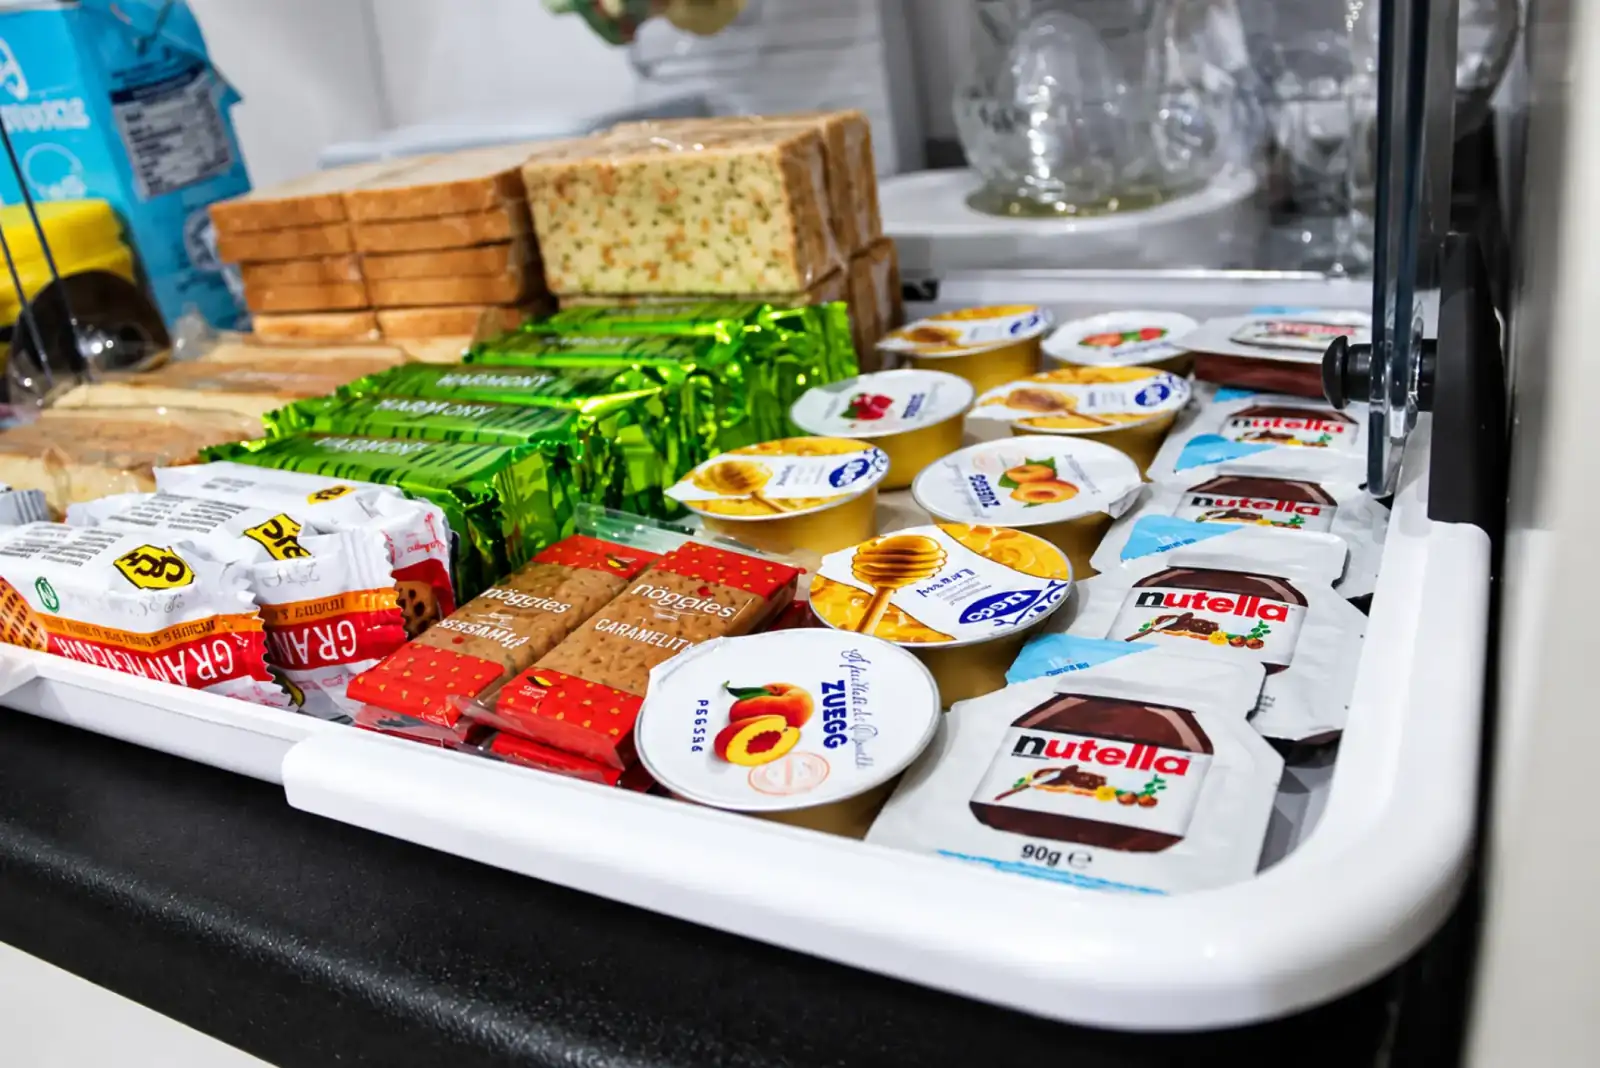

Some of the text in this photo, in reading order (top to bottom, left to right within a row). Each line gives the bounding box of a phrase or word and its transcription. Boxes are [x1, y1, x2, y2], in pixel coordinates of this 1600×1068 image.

[373, 398, 496, 417] HARMONY
[1231, 417, 1344, 434] nutella
[1190, 495, 1321, 517] nutella
[480, 588, 572, 614] nöggies
[631, 583, 737, 618] nöggies
[1135, 591, 1290, 623] nutella
[820, 679, 849, 750] ZUEGG
[1011, 735, 1192, 776] nutella
[1020, 843, 1062, 867] 90g
